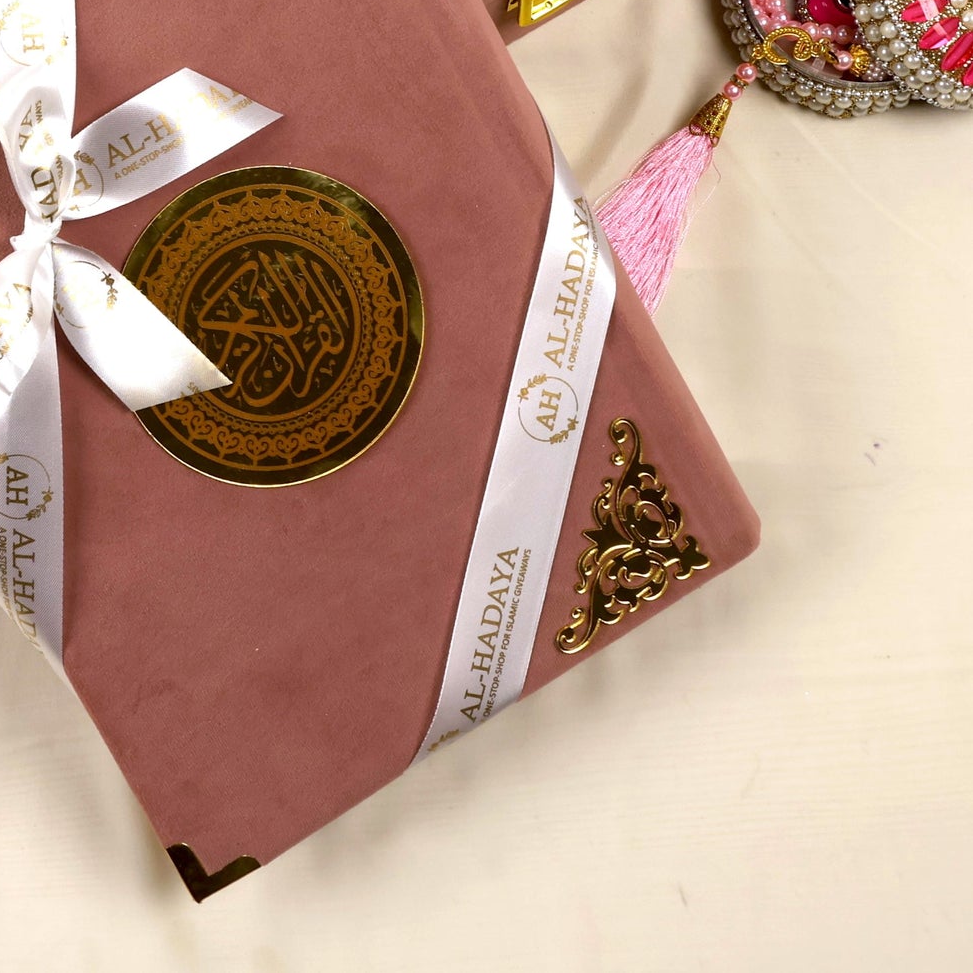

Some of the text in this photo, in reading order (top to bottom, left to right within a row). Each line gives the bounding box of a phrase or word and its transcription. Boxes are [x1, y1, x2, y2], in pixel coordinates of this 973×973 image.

[543, 196, 590, 369] AL-HADAYA
[569, 295, 590, 364] ONE-STOP-SHOP
[585, 278, 595, 295] FOR
[536, 391, 562, 432] AH
[7, 466, 28, 506] AH
[515, 548, 532, 596] GIVEAWAYS
[460, 547, 519, 723] AL-HADAYA
[505, 596, 519, 632] ISLAMIC
[502, 631, 511, 651] FOR
